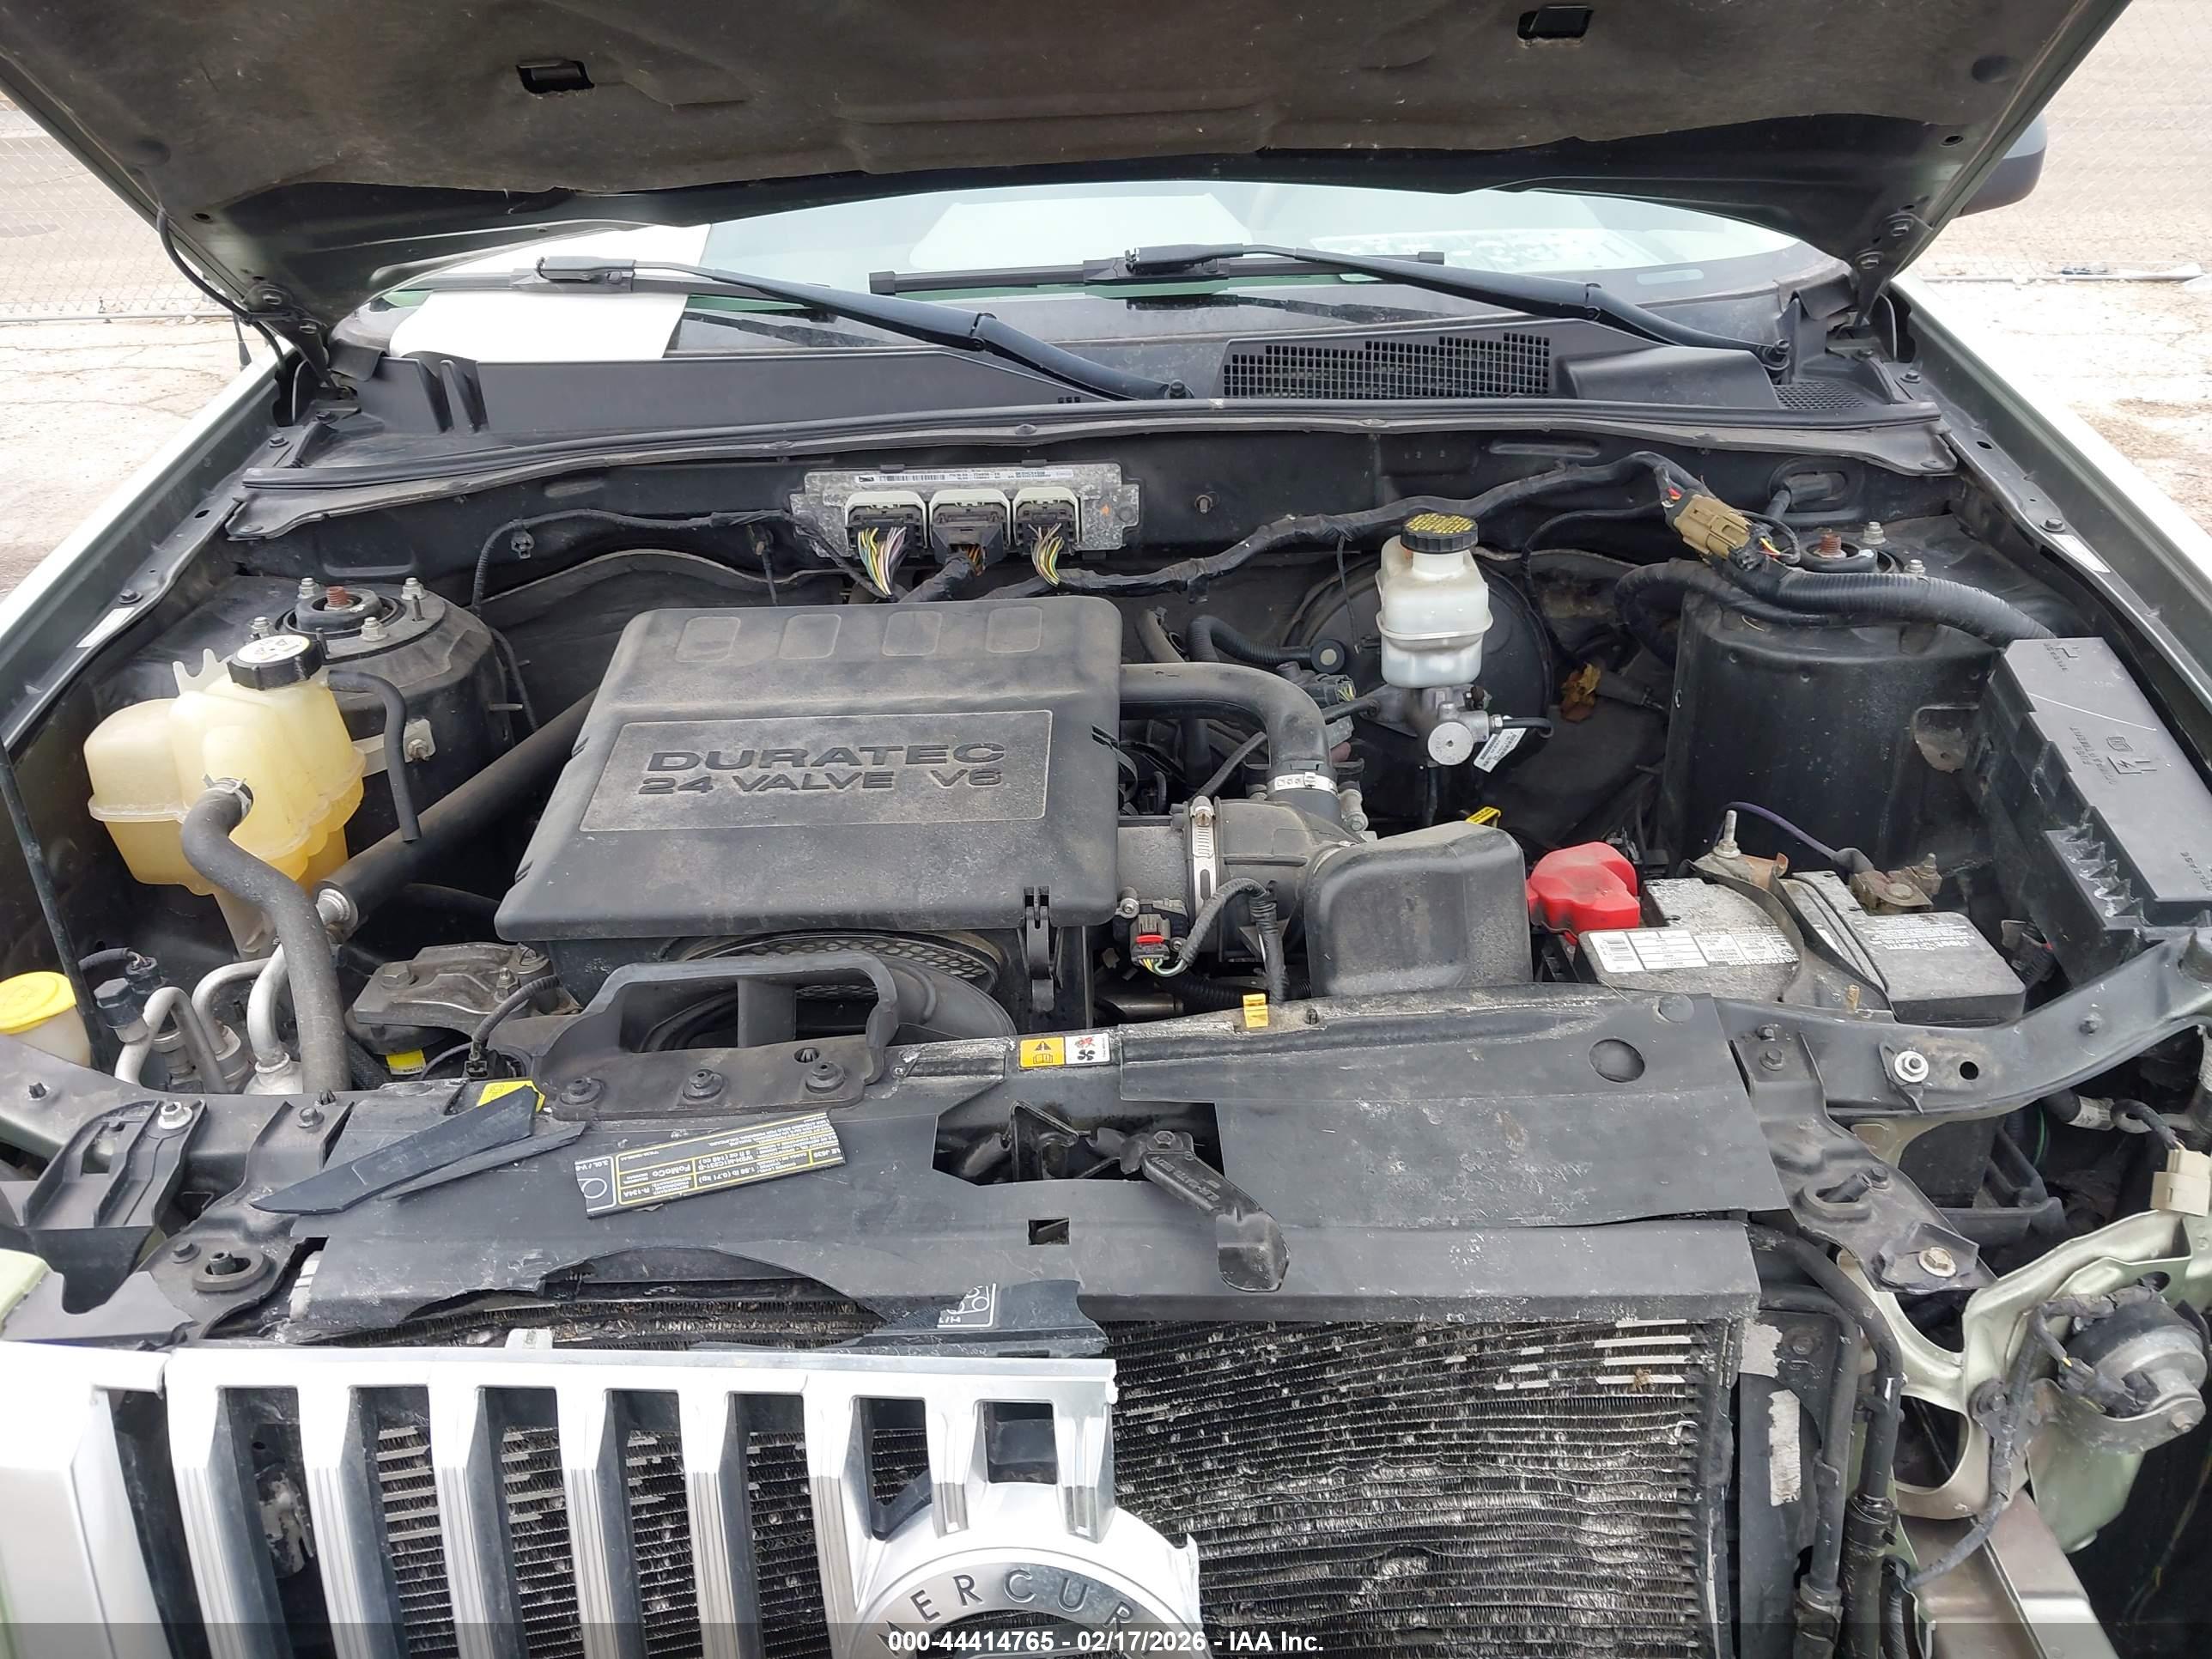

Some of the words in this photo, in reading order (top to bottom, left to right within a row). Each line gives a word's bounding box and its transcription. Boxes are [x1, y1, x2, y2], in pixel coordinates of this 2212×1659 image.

[647, 741, 1006, 773] DURATEC
[637, 776, 714, 795] 24
[731, 769, 894, 792] VALVE
[928, 767, 1004, 787] V6
[1883, 941, 1920, 950] Farm
[1934, 939, 1970, 949] Fleet
[652, 1164, 691, 1177] FoMoCo
[698, 1175, 712, 1183] kg)
[713, 1171, 732, 1181] (0.71
[623, 1187, 650, 1198] R-134A
